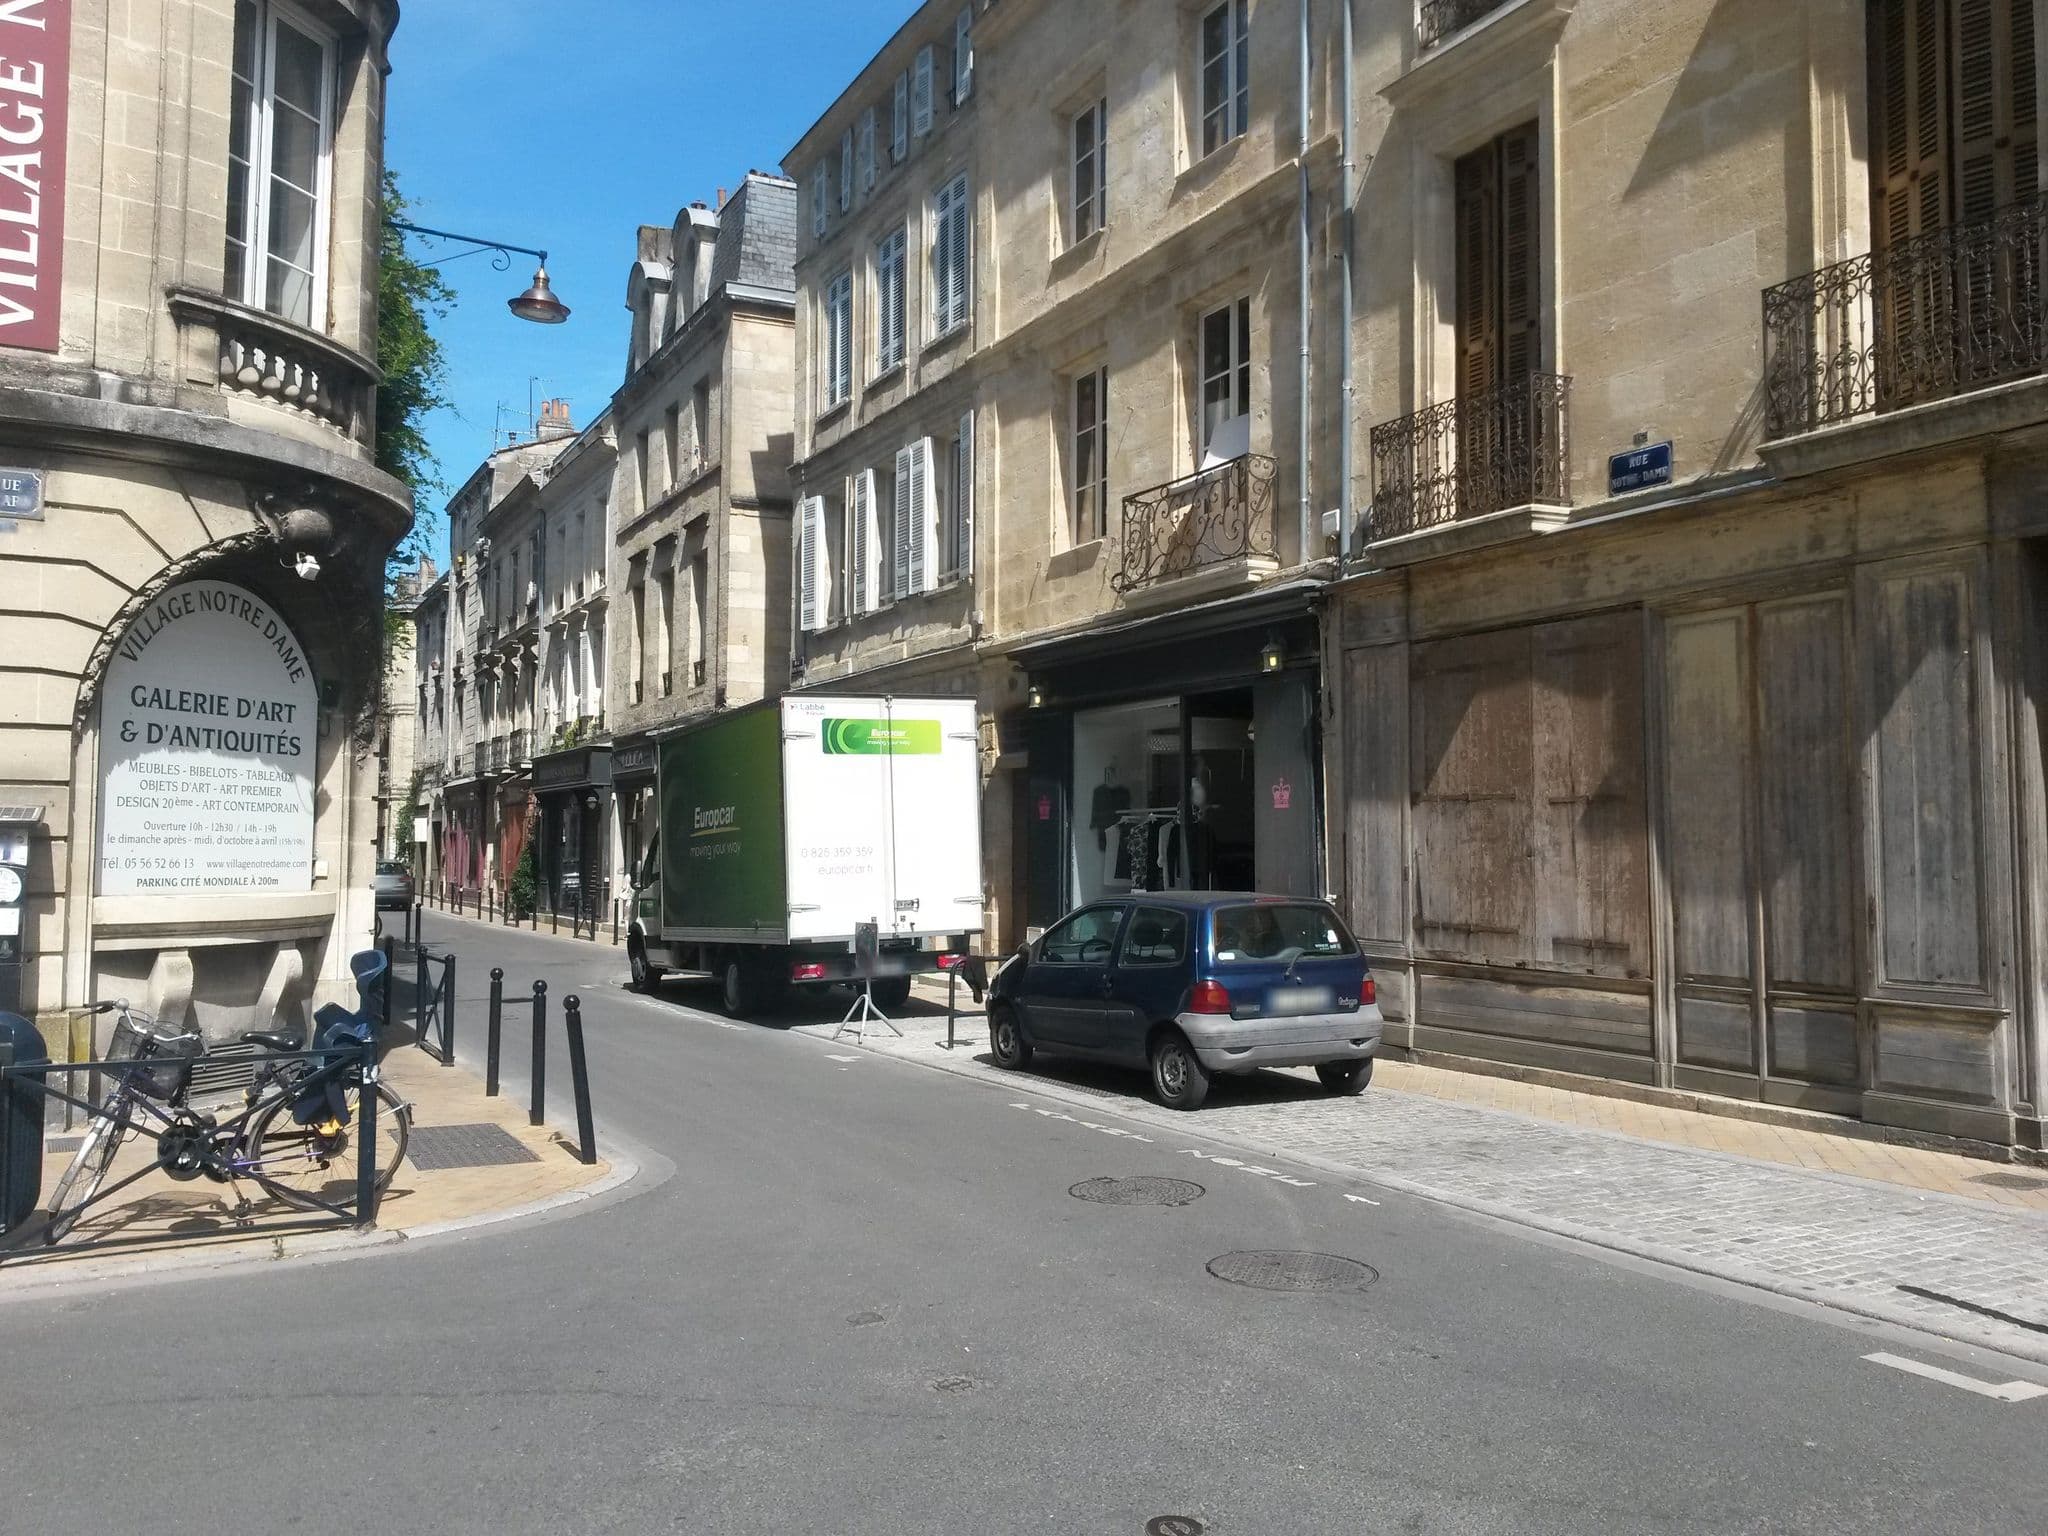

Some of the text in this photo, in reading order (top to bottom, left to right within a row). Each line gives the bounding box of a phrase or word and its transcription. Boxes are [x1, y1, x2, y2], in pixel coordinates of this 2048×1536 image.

[0, 56, 45, 327] VILLAGE
[1629, 454, 1649, 469] RUE
[119, 590, 305, 684] VILLAGE NOTRE DAME
[130, 685, 296, 724] GALERIE D'ART
[120, 719, 301, 756] & D'ANTIQUITÉS
[128, 761, 180, 775] MEUBLES
[189, 766, 238, 779] BIBELOTS
[246, 769, 294, 783] TABLEAUX
[139, 779, 178, 792] OBJETS
[181, 781, 211, 793] D'ART
[219, 784, 239, 795] ART
[241, 785, 282, 797] PREMIER
[116, 796, 159, 808] DESIGN
[162, 796, 194, 809] 20ème
[202, 800, 221, 810] ART
[223, 800, 299, 813] CONTEMPORAIN
[143, 820, 187, 831] Ouverture
[189, 822, 203, 831] 10h
[211, 822, 234, 832] 12h30
[244, 823, 257, 833] 14h
[264, 823, 277, 833] 19h
[694, 806, 736, 831] Europcar
[107, 833, 116, 843] le
[118, 833, 162, 844] dimanche
[163, 836, 187, 846] après
[216, 835, 254, 845] d'octobre
[261, 836, 278, 845] avril
[689, 845, 712, 860] moving
[810, 847, 831, 858] 825
[833, 847, 852, 857] 359
[855, 846, 873, 857] 359
[124, 857, 137, 869] 05
[140, 857, 152, 869] 56
[154, 857, 166, 869] 52
[168, 858, 181, 869] 66
[184, 858, 194, 869] 13
[206, 858, 308, 870] www.villagenotredame.com
[136, 875, 279, 887] PARKING CITÉ MONDIALE À 200m
